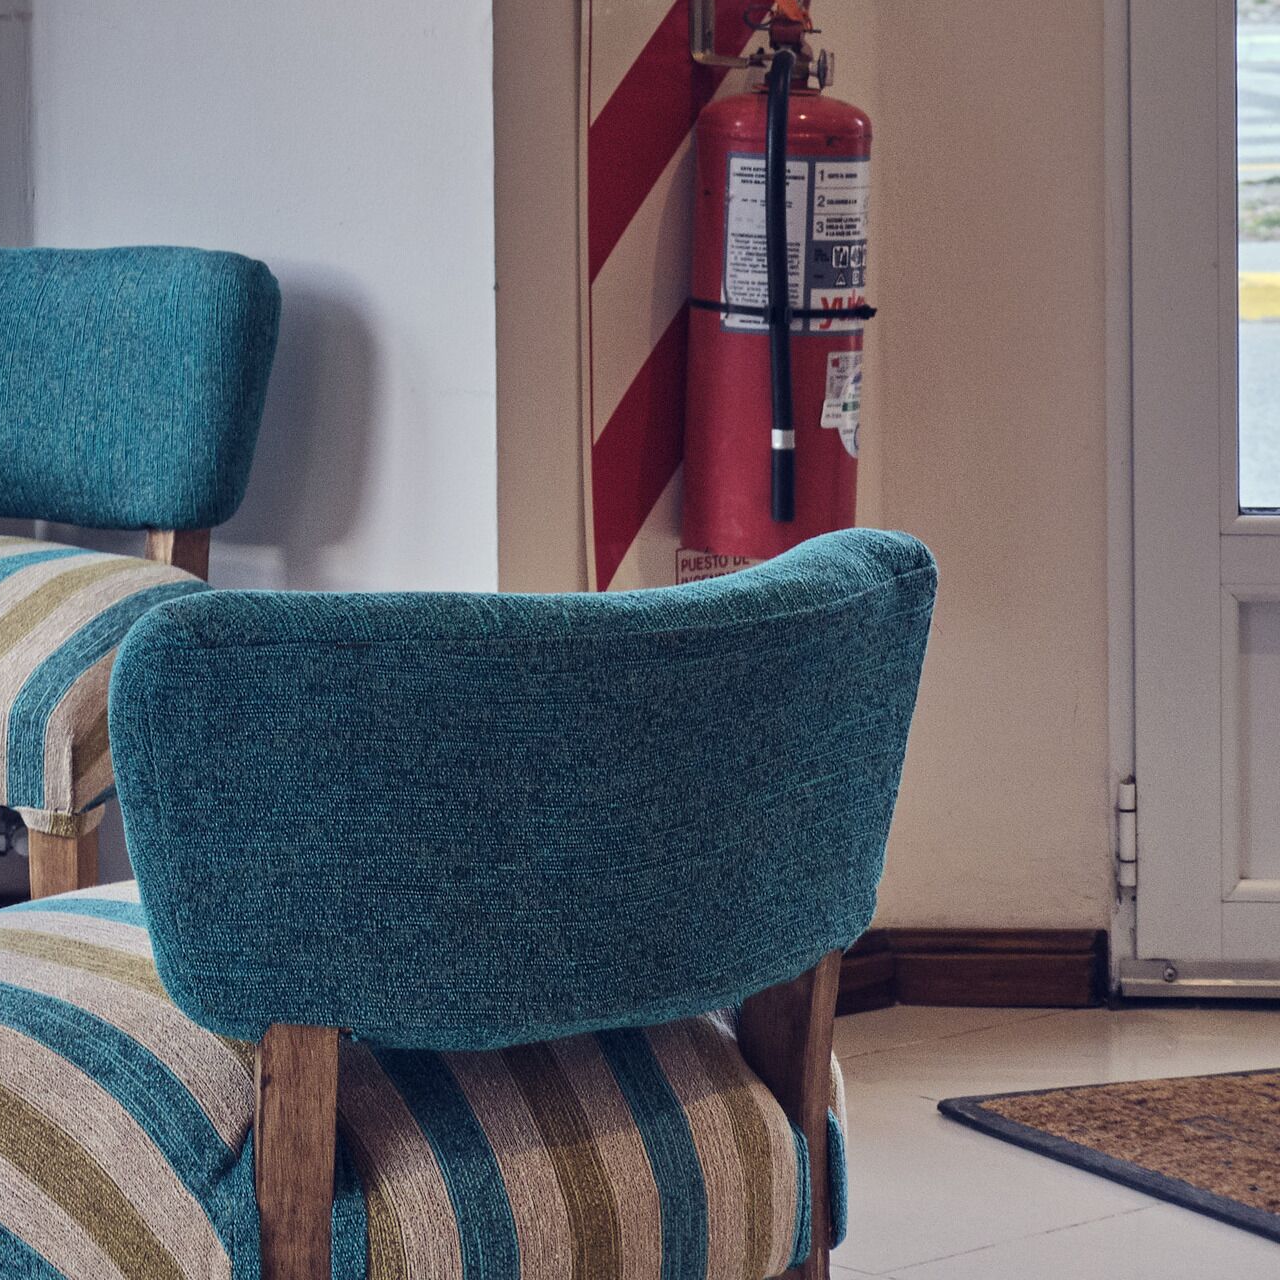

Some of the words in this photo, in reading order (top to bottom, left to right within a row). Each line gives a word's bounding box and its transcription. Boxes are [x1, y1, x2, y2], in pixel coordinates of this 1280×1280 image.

[818, 169, 825, 182] 1
[817, 195, 826, 208] 2
[815, 220, 825, 233] 3
[681, 554, 728, 572] PUESTO
